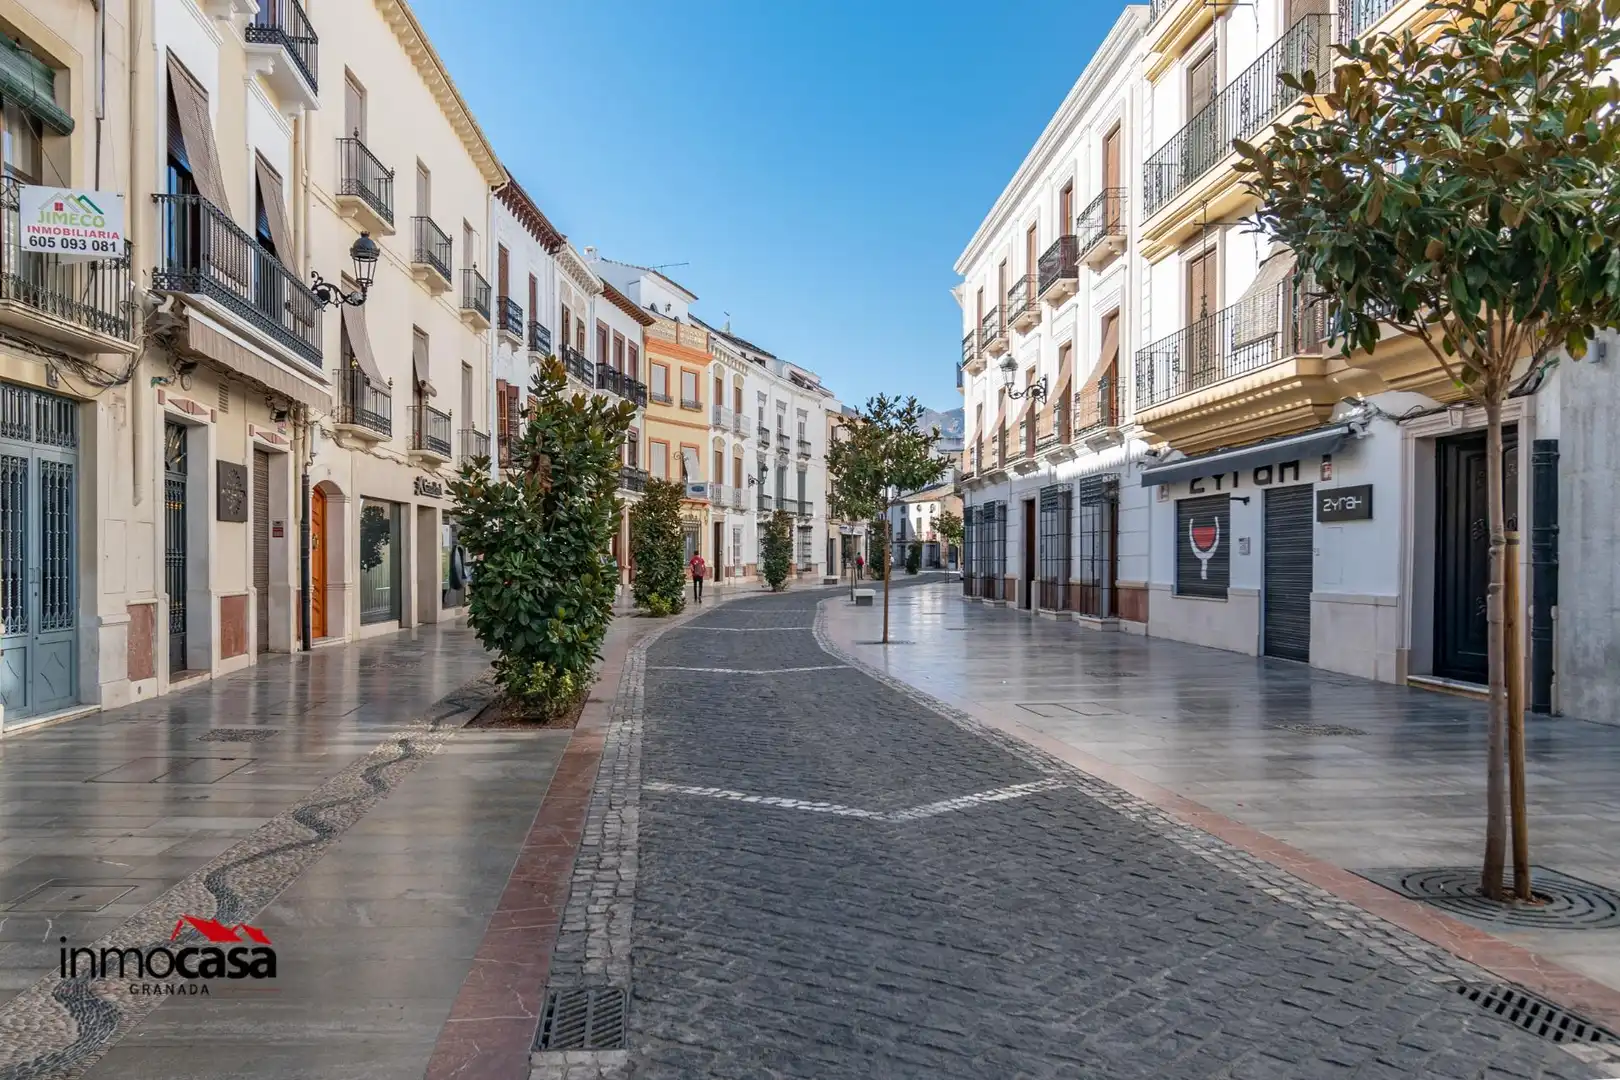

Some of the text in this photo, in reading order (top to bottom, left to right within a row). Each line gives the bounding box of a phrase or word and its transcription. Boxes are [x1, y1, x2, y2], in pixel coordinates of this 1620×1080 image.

[38, 210, 105, 228] JIMECO
[27, 225, 120, 239] INMOBILIARIA
[29, 236, 116, 252] 605 093 081
